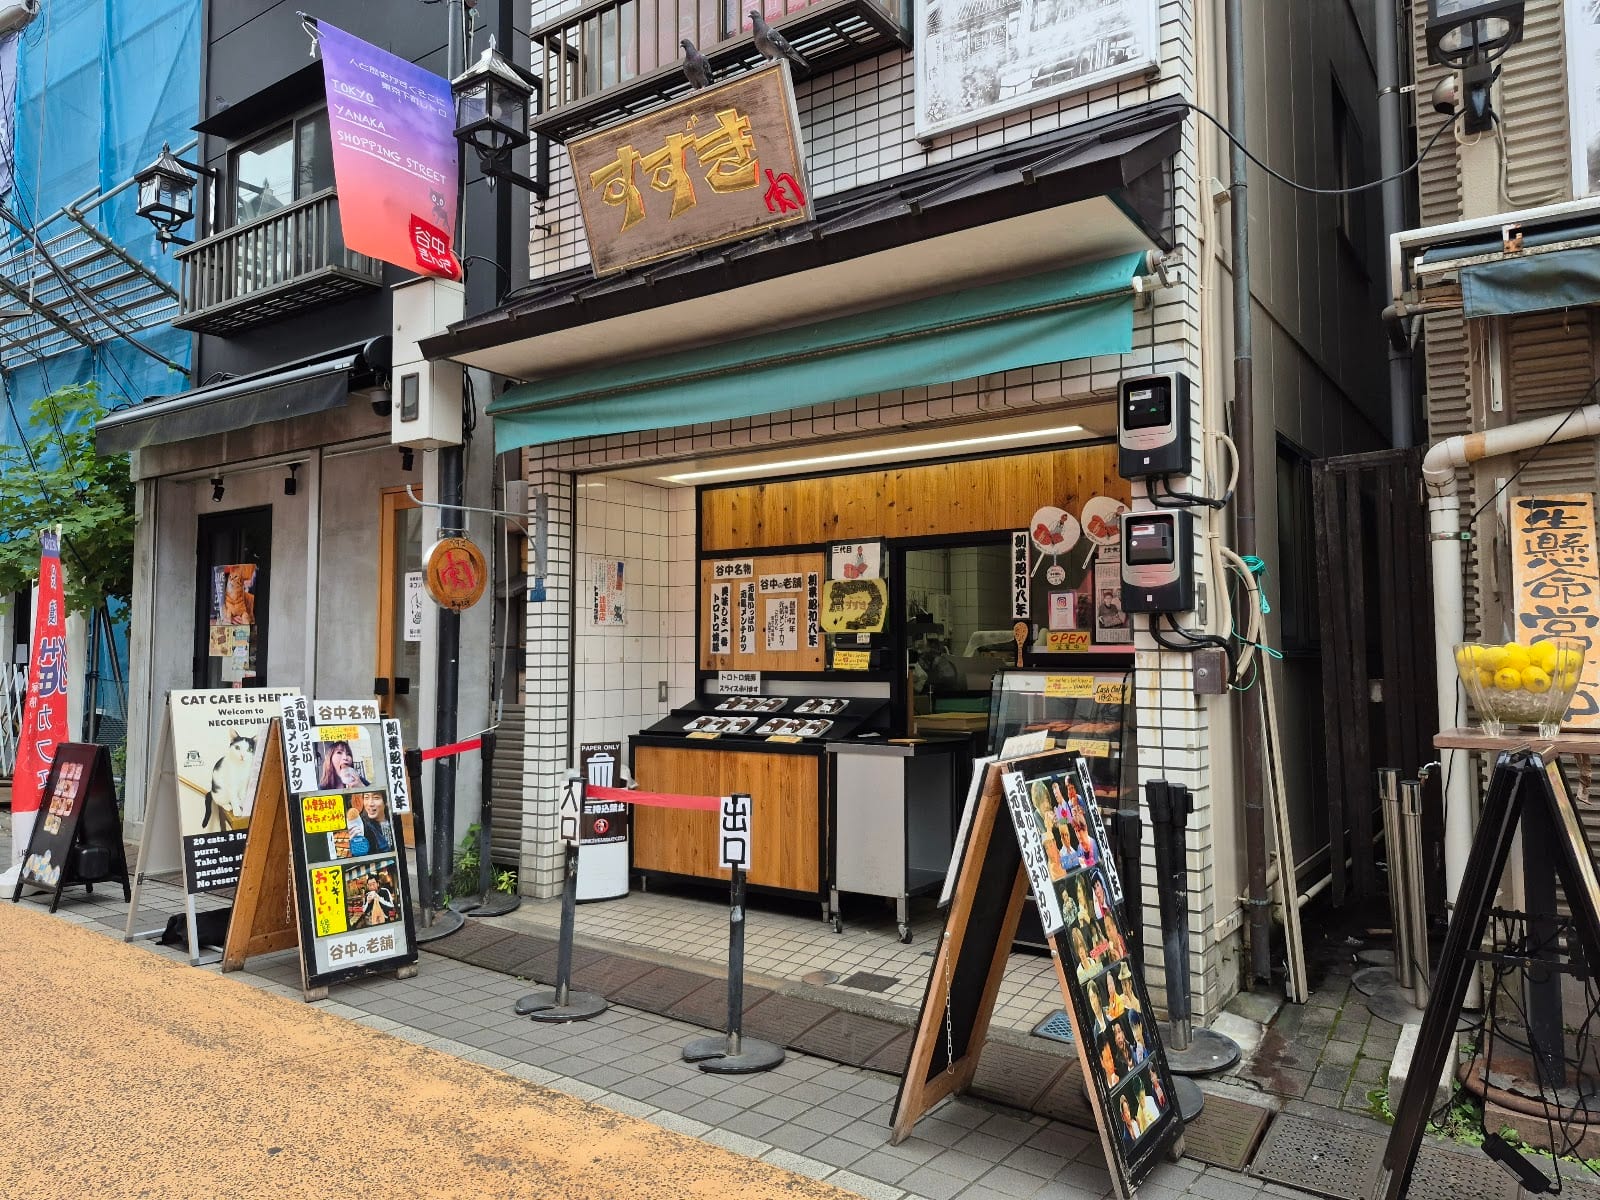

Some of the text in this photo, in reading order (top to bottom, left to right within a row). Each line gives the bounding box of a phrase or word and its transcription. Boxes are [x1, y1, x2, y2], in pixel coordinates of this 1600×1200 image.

[331, 78, 374, 103] TOKYO
[334, 104, 385, 131] YANAKA
[337, 130, 446, 185] SHOPPING STREET
[589, 108, 759, 234] すずき
[414, 225, 446, 256] 谷中
[419, 248, 453, 275] ぎんざ
[832, 545, 852, 554] 三代目
[715, 563, 752, 576] 谷中名物
[760, 576, 802, 590] 谷中の老舗
[1014, 534, 1027, 617] 創業昭和八年
[747, 583, 755, 632] 元気いっぱい
[807, 573, 818, 647] 創業昭和八年
[1513, 499, 1600, 723] 一生懸命営
[1050, 632, 1088, 644] OPEN
[181, 695, 206, 705] CAT
[210, 694, 242, 704] CAFE
[245, 693, 255, 703] is
[1096, 685, 1110, 693] Cash
[208, 717, 270, 727] NECOREPUBLI
[318, 704, 377, 720] 谷中名物
[295, 698, 313, 764] 元気いっぱい
[283, 705, 303, 791] 元気メンチカツ
[386, 721, 408, 812] 創業昭和八年
[561, 782, 578, 841] 入口
[193, 832, 247, 846] 20 cats. 2 flo
[722, 797, 748, 865] 出口
[1015, 774, 1049, 883] 元気いっぱい
[194, 847, 220, 858] purrs.
[195, 858, 217, 867] Take
[219, 855, 234, 864] the
[1008, 790, 1054, 930] 元気メンチカツ
[196, 866, 234, 879] paradise
[197, 876, 239, 888] No reserv
[329, 869, 341, 905] マッキー
[329, 934, 394, 961] 谷中の老舗
